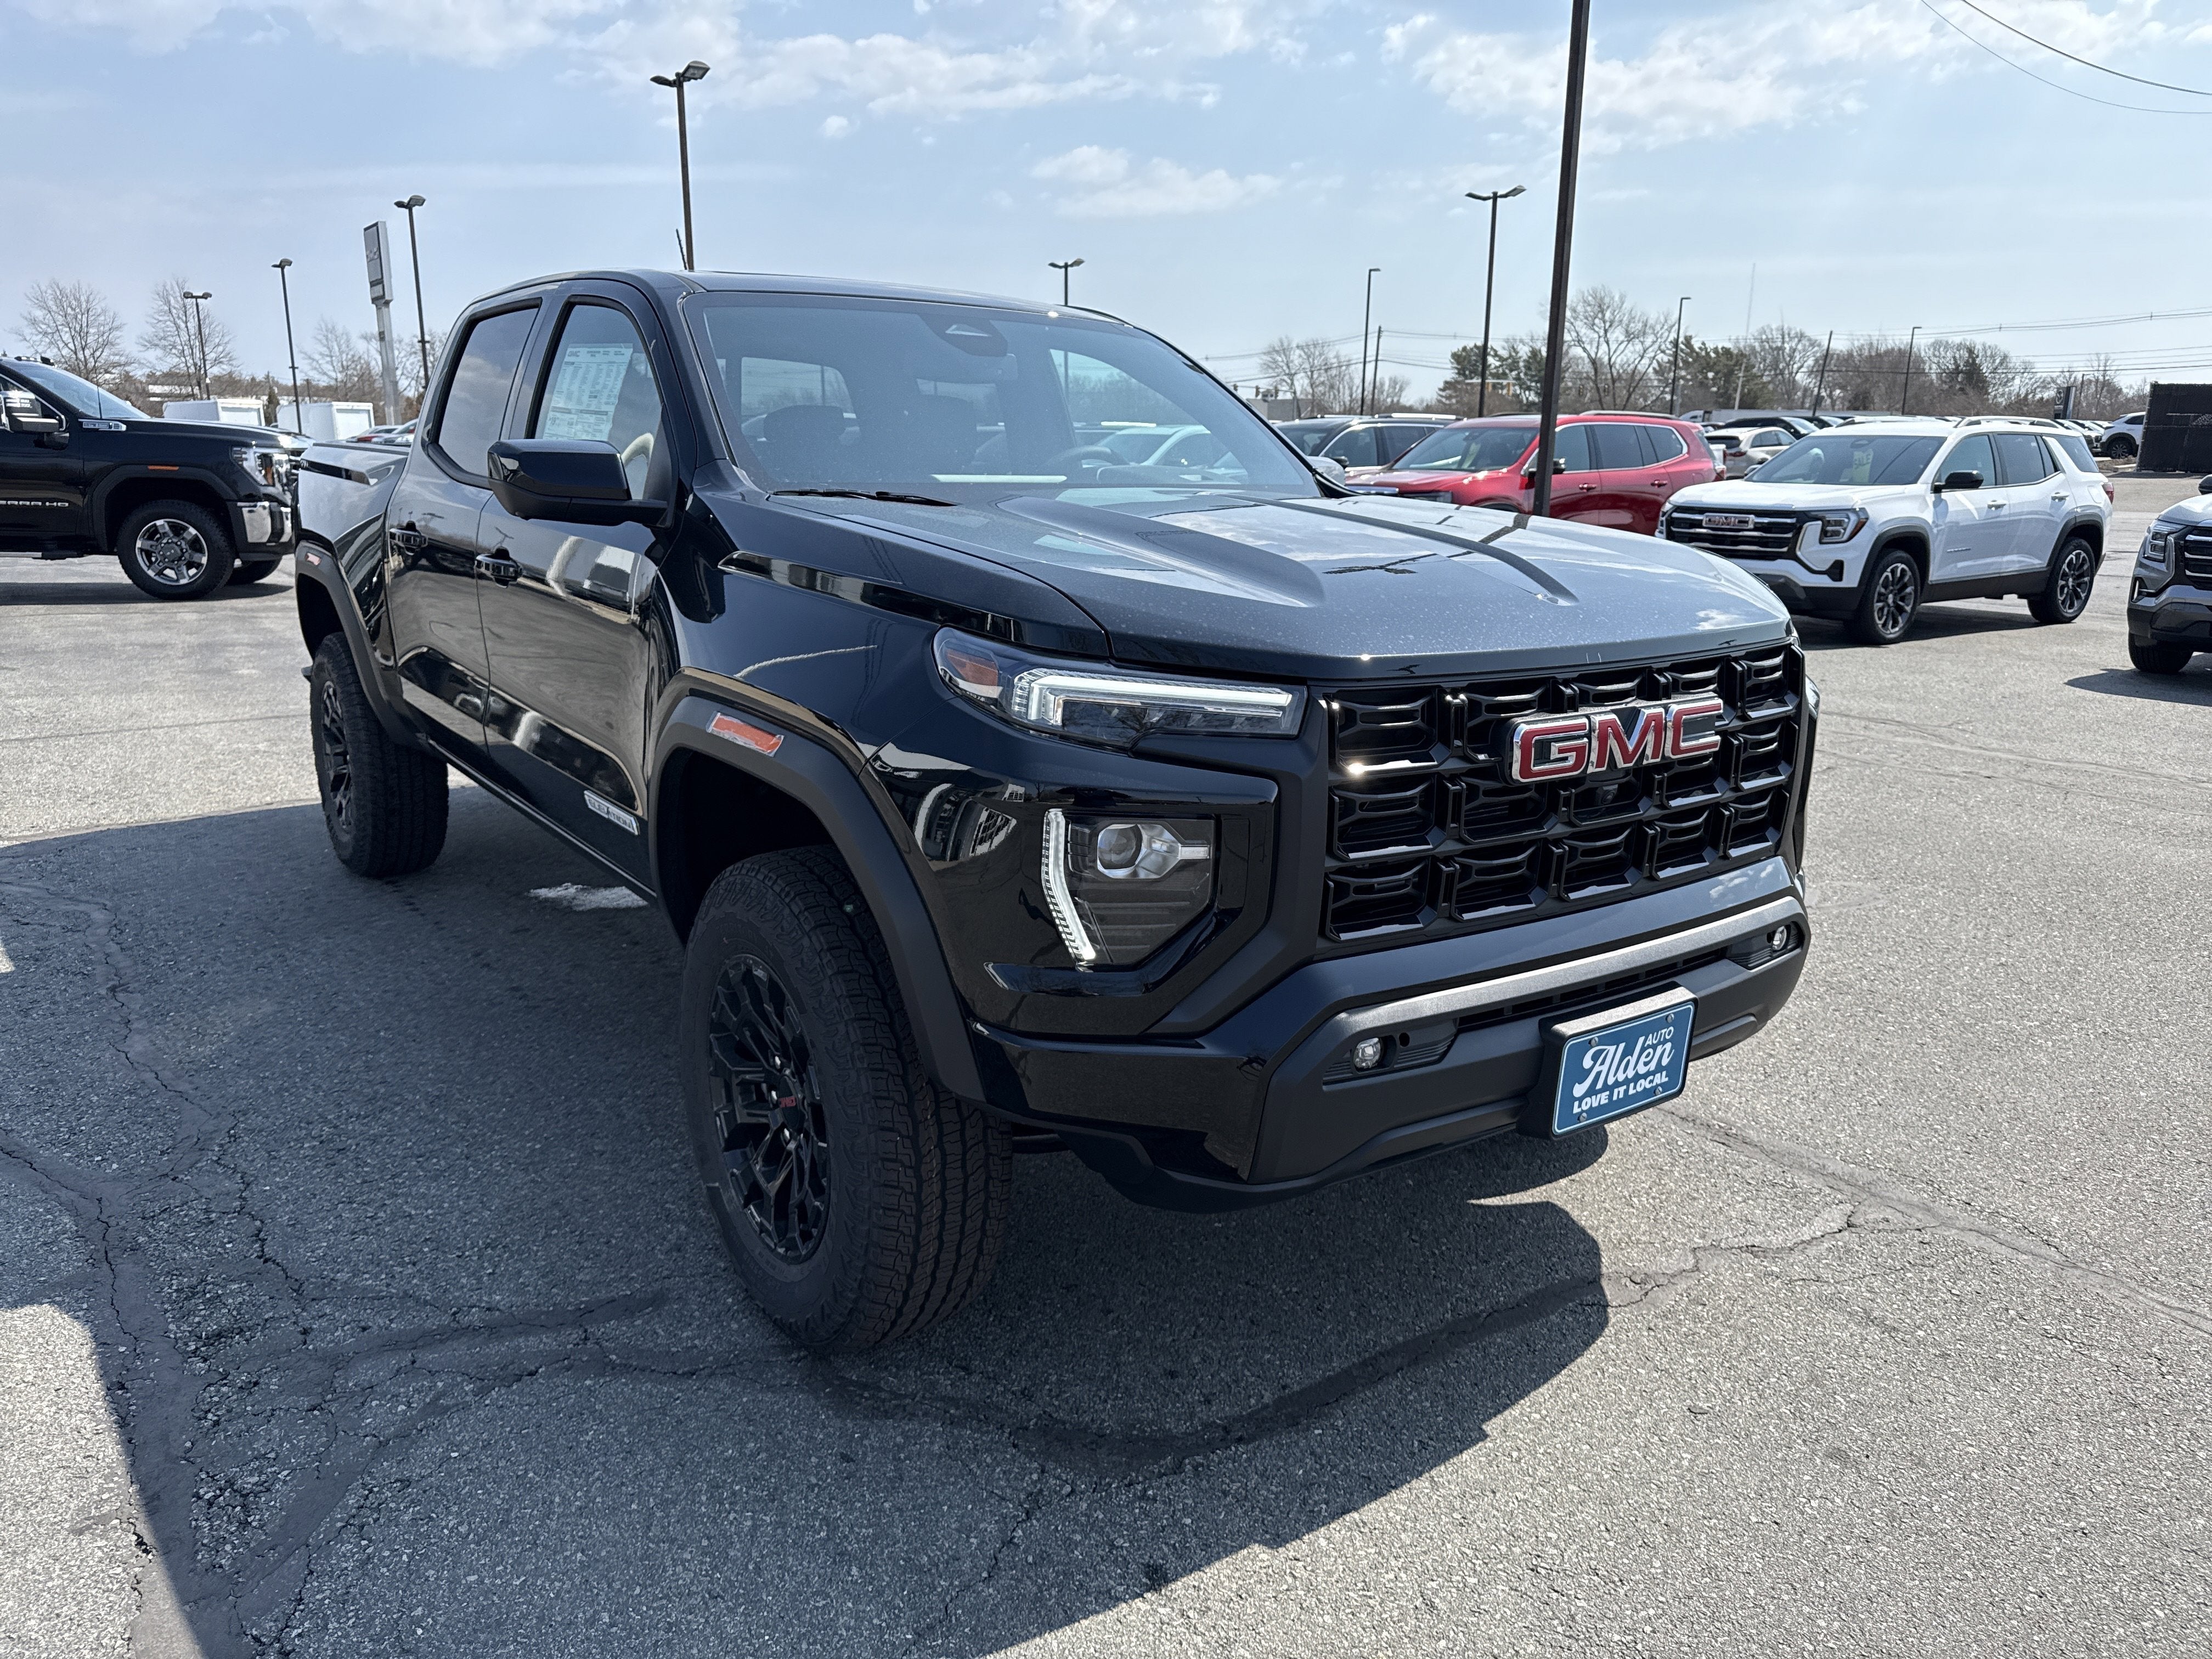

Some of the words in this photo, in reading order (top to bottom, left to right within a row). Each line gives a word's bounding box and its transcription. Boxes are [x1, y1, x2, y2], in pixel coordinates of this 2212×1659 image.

[1703, 514, 1751, 528] GMC
[1512, 698, 1723, 782] GMC
[1644, 1026, 1674, 1047] AUTO
[1573, 1036, 1675, 1098] Alden
[1573, 1091, 1609, 1114] LOVE
[1612, 1085, 1628, 1101] IT
[1628, 1071, 1668, 1095] LOCAL
